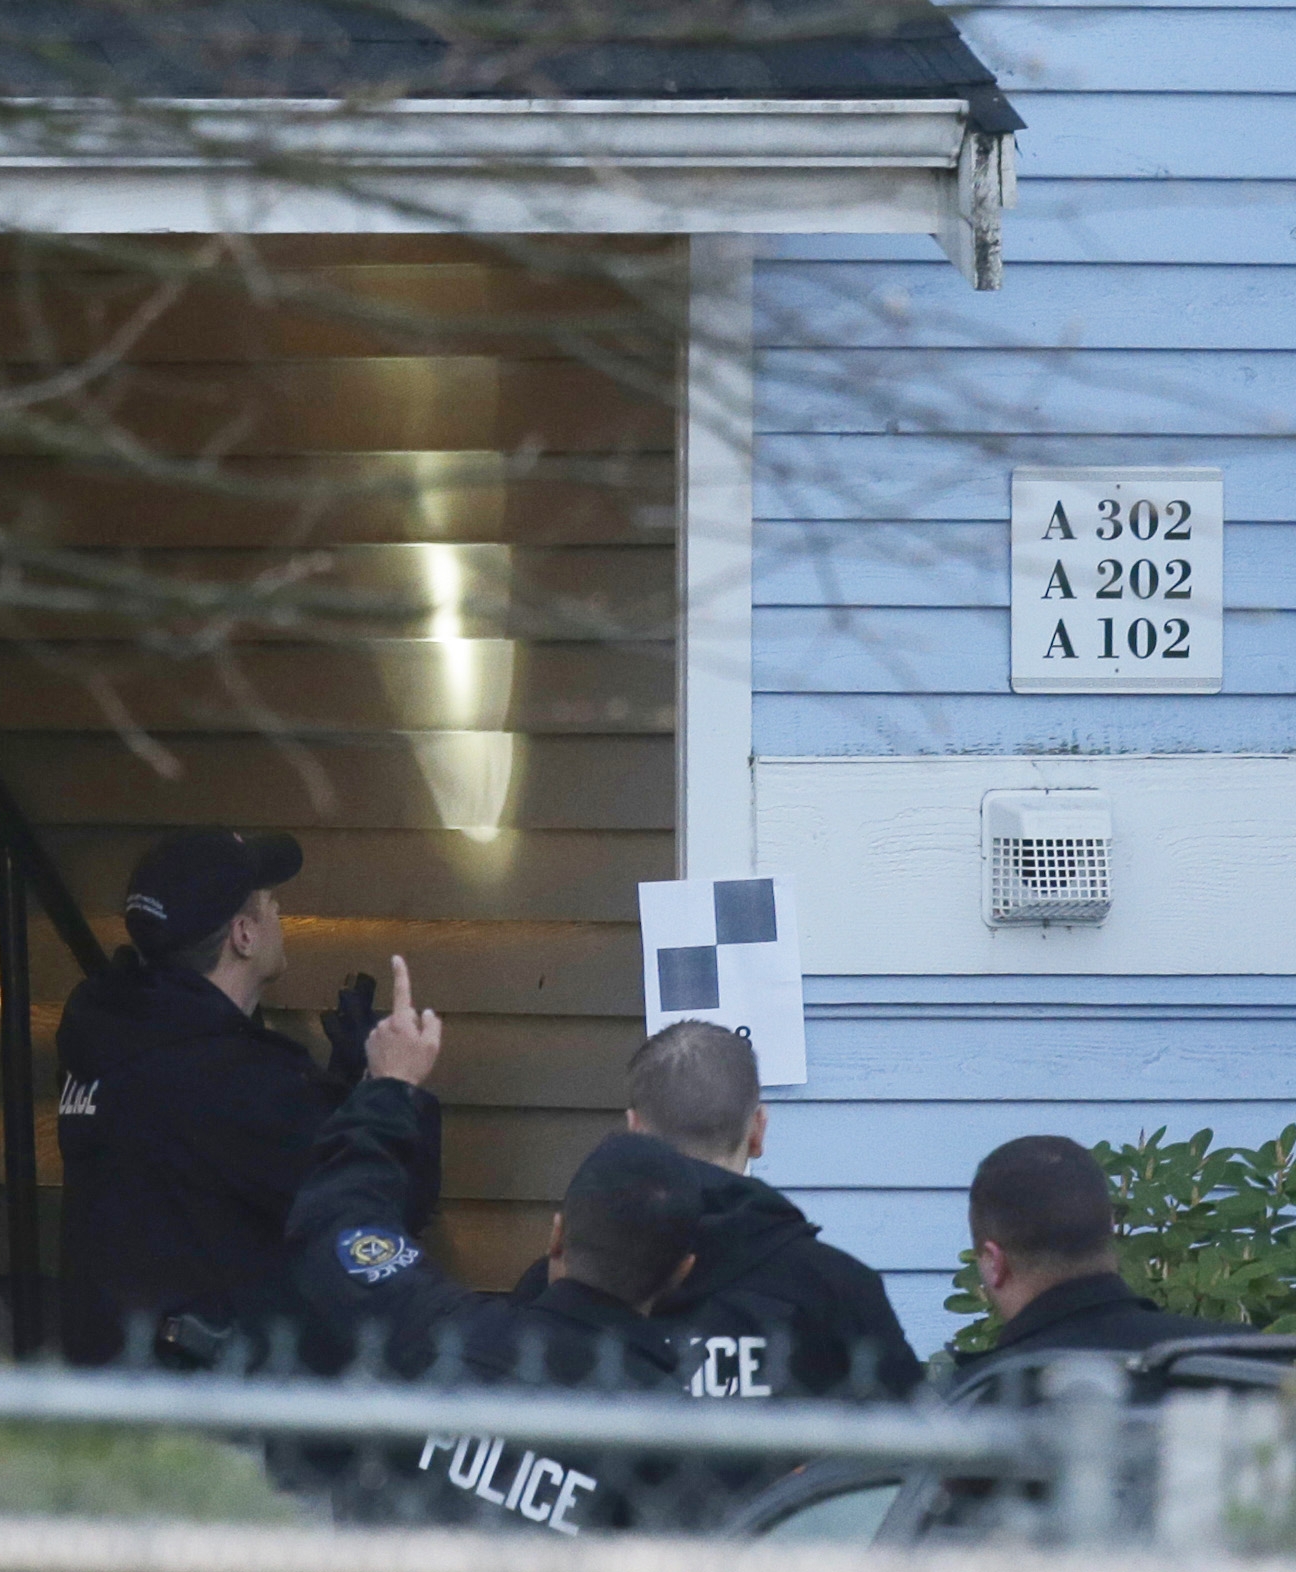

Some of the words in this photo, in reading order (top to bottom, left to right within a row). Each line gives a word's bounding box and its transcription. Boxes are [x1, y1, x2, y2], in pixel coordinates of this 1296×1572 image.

[1041, 499, 1077, 540] A
[1095, 499, 1192, 541] 302
[1041, 558, 1077, 599] A
[1095, 558, 1192, 600] 202
[1042, 618, 1079, 659] A
[1097, 617, 1190, 659] 102
